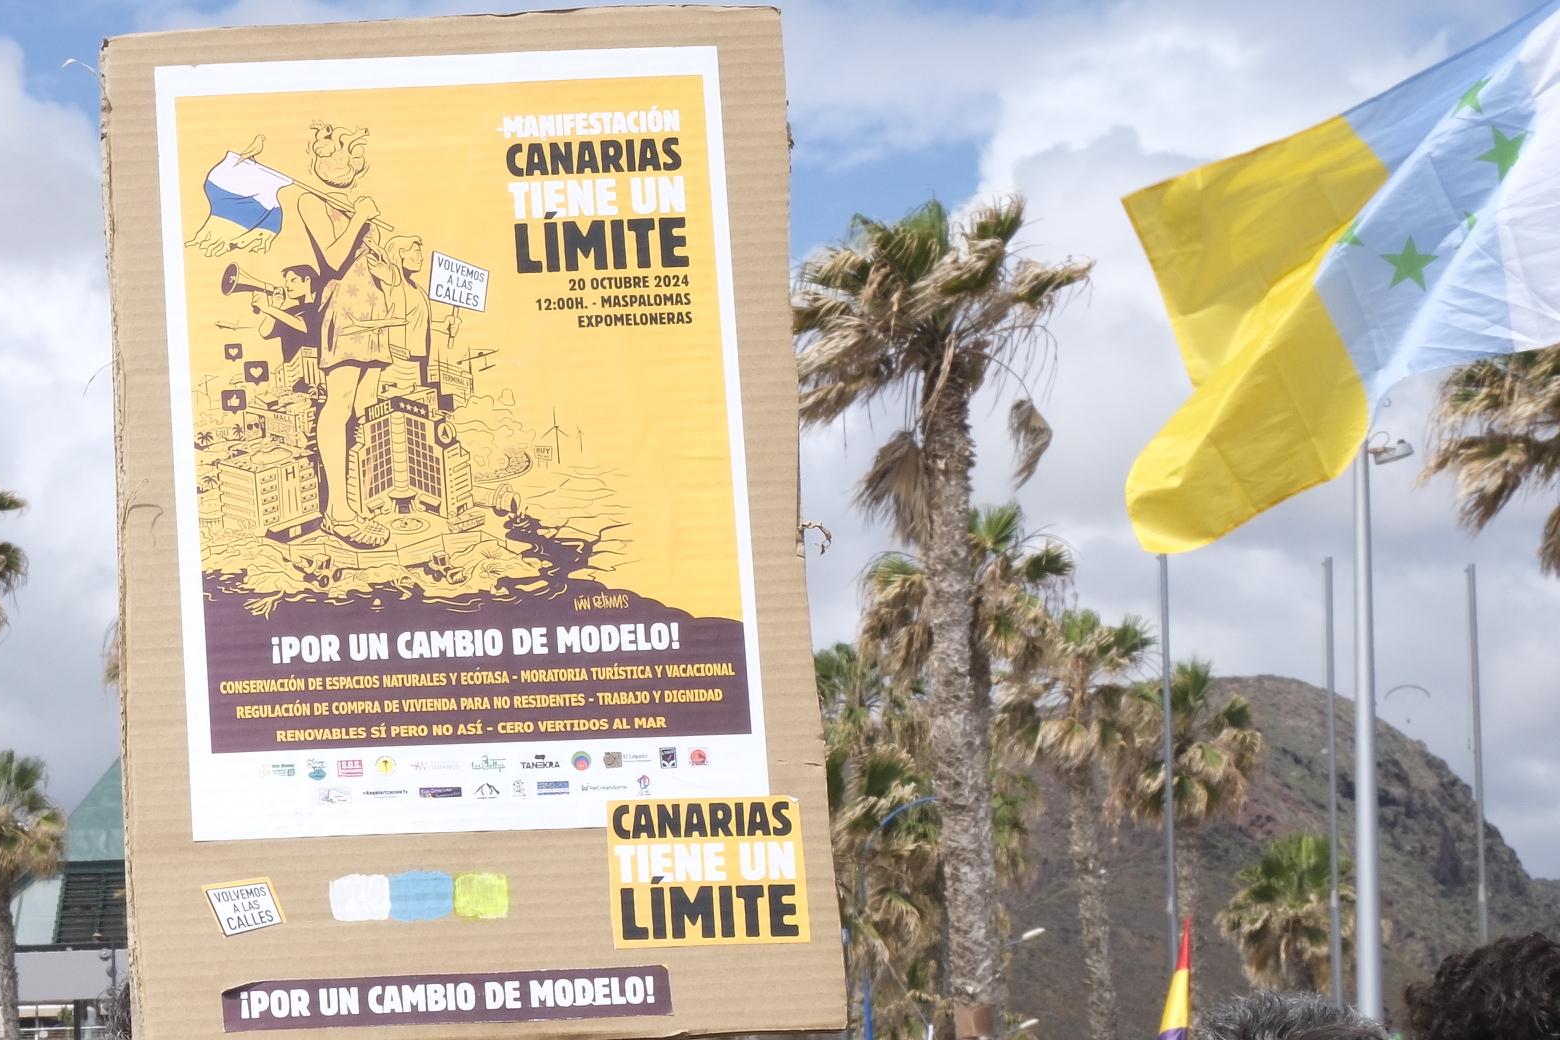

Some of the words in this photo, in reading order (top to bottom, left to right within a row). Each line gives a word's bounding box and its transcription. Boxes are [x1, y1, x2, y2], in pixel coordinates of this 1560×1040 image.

[502, 106, 680, 139] MANIFESTACIÓN
[506, 137, 682, 177] CANARIAS
[508, 178, 618, 219] TIENE
[630, 176, 686, 215] UN
[514, 211, 689, 273] LÍMITE
[438, 256, 485, 282] VOLVEMOS
[447, 274, 453, 285] A
[456, 277, 473, 290] LAS
[568, 278, 586, 291] 20
[590, 275, 649, 290] OCTUBRE
[654, 274, 690, 288] 2024
[436, 284, 479, 307] CALLES
[536, 297, 588, 311] 12:00H.
[601, 293, 691, 308] MASPALOMAS
[578, 311, 693, 328] EXPOMELONERAS
[368, 401, 393, 421] HOTEL
[271, 634, 341, 664] ¡POR
[348, 632, 389, 662] UN
[397, 628, 503, 660] CAMBIO
[512, 626, 547, 656] DE
[556, 622, 680, 655] MODELO!
[220, 675, 305, 695] CONSERVACIÓN
[308, 678, 323, 691] DE
[326, 675, 380, 690] ESPACIOS
[383, 672, 447, 688] NATURALES
[449, 673, 457, 686] Y
[520, 667, 588, 683] MORATORIA
[591, 663, 653, 680] TURÍSTICA
[655, 666, 663, 678] Y
[665, 663, 735, 678] VACACIONAL
[236, 700, 310, 719] REGULACIÓN
[313, 703, 329, 716] DE
[332, 701, 381, 715] COMPRA
[385, 700, 400, 713] DE
[402, 698, 458, 712] VIVIENDA
[460, 696, 490, 710] PARA
[493, 696, 511, 709] NO
[513, 693, 586, 708] RESIDENTES
[597, 690, 650, 705] TRABAJO
[653, 690, 661, 703] Y
[664, 688, 723, 703] DIGNIDAD
[276, 727, 367, 743] RENOVABLES
[370, 723, 387, 739] SÍ
[391, 724, 428, 738] PERO
[432, 723, 453, 736] NO
[457, 720, 483, 735] ASÍ
[497, 721, 534, 734] CERO
[538, 718, 609, 732] VERTIDOS
[612, 717, 630, 730] AL
[634, 716, 667, 729] MAR
[613, 800, 792, 840] CANARIAS
[614, 844, 730, 883] TIENE
[739, 841, 796, 881] UN
[213, 886, 267, 903] VOLVEMOS
[233, 903, 240, 913] A
[241, 900, 261, 912] LAS
[621, 876, 800, 941] LÍMITE
[226, 909, 274, 930] CALLES
[240, 987, 311, 1020] ¡POR
[319, 985, 360, 1016] UN
[367, 982, 477, 1014] CAMBIO
[485, 980, 522, 1010] DE
[530, 976, 655, 1009] MODELO!
